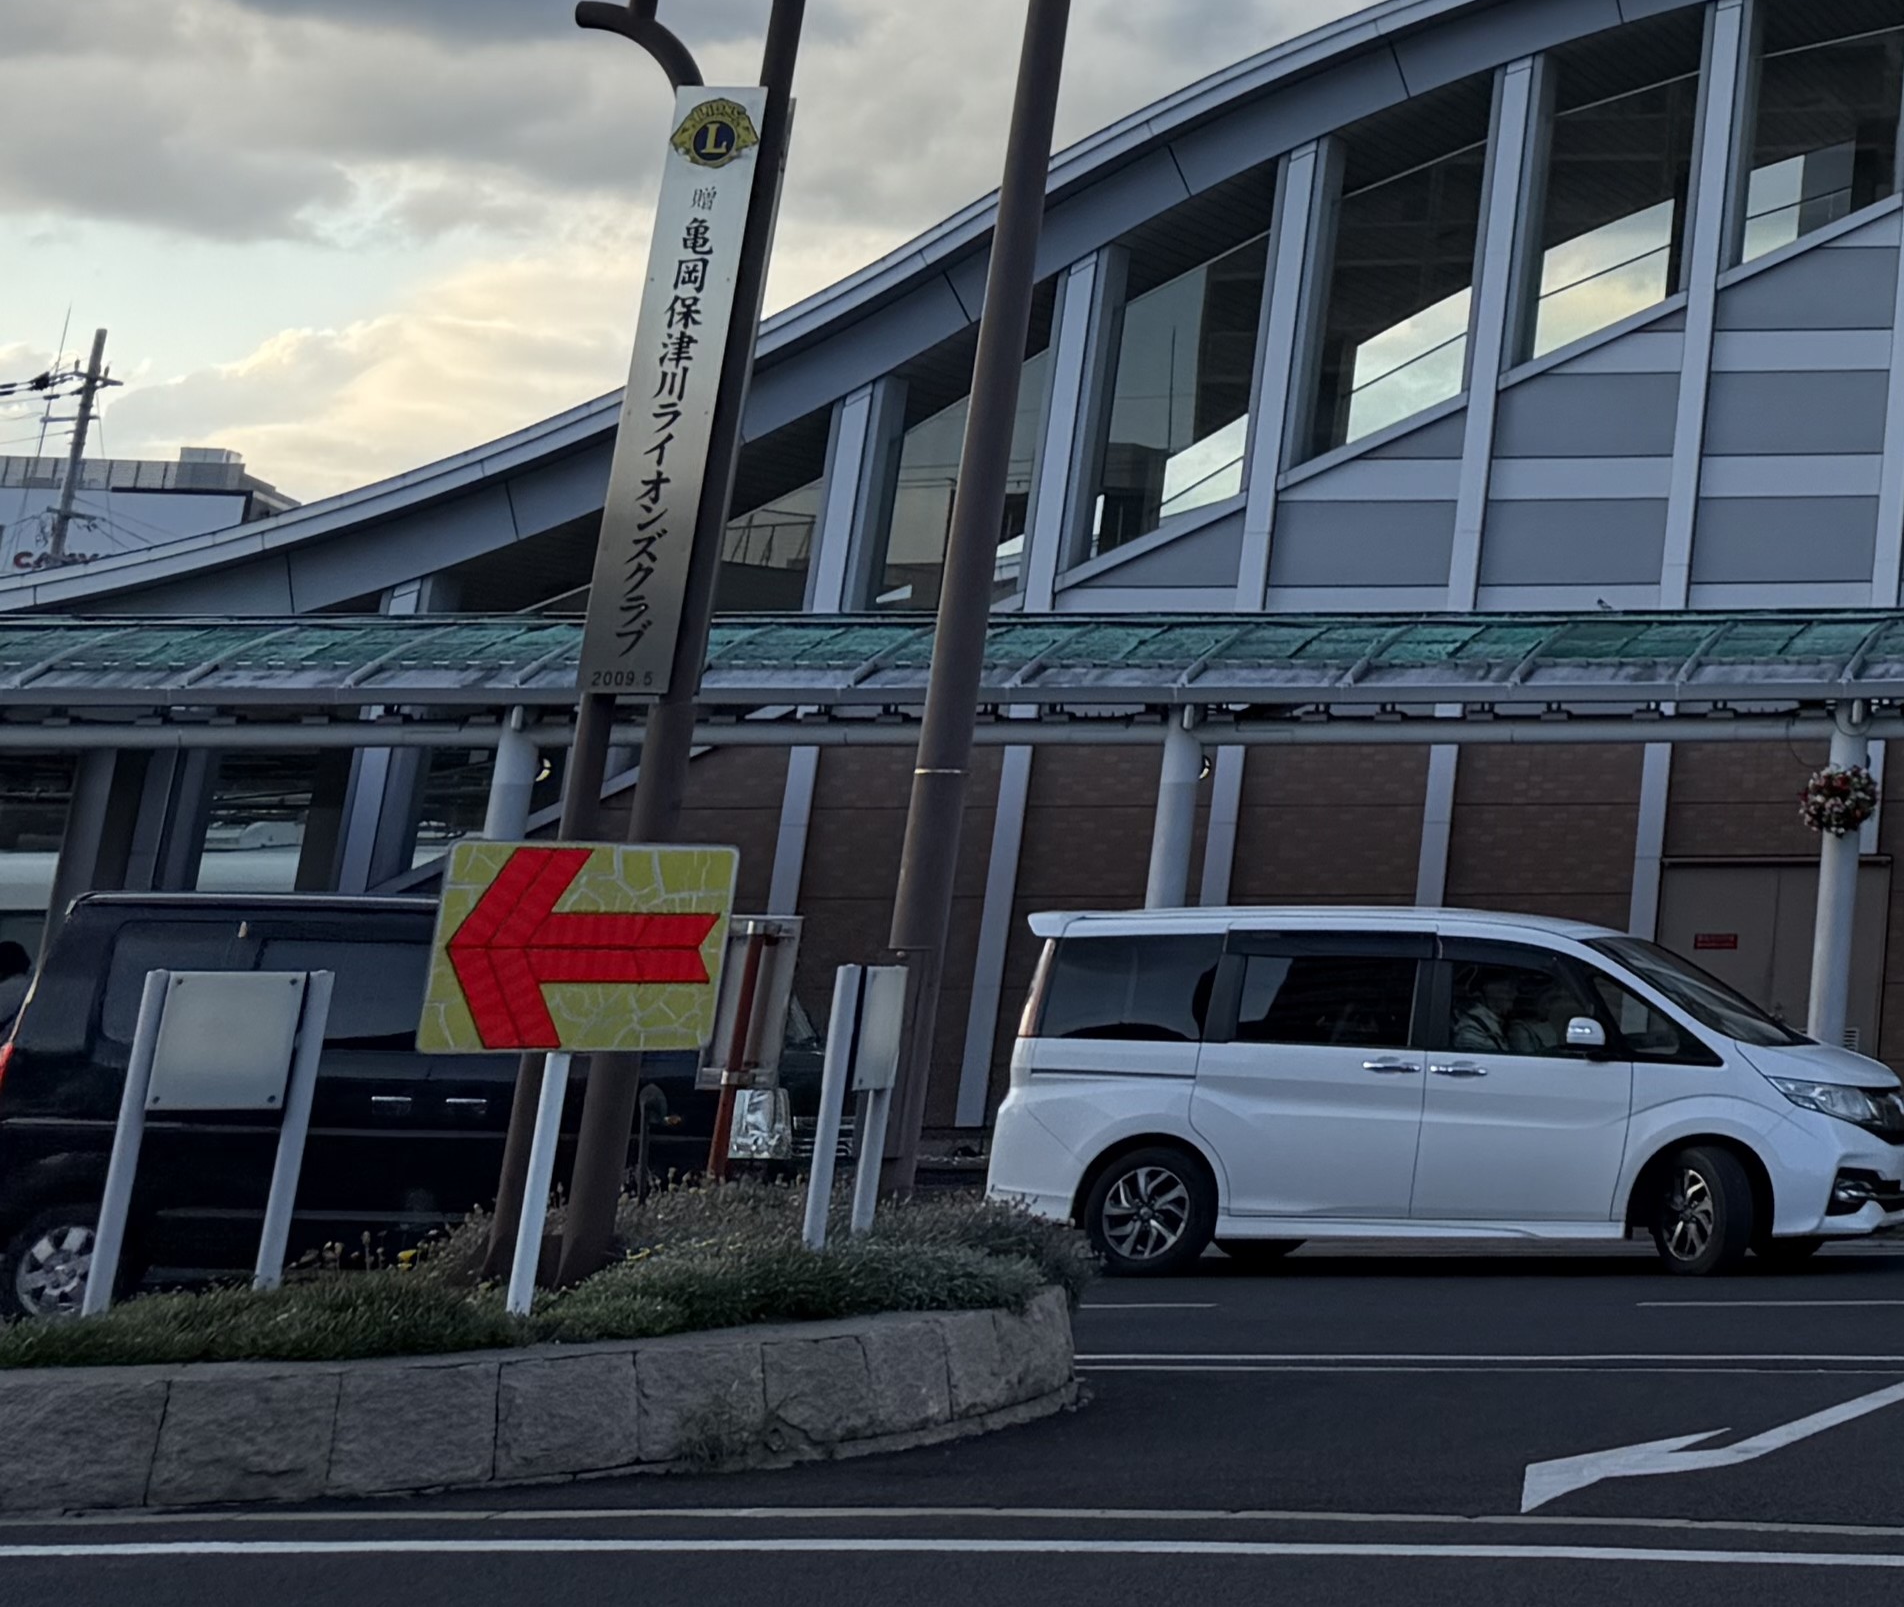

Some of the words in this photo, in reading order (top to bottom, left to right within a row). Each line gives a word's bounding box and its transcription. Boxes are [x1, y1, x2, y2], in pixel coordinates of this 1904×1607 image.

[700, 123, 728, 154] L
[688, 185, 718, 212] 贈
[616, 216, 714, 658] 亀岡保津川ライオンズクラブ
